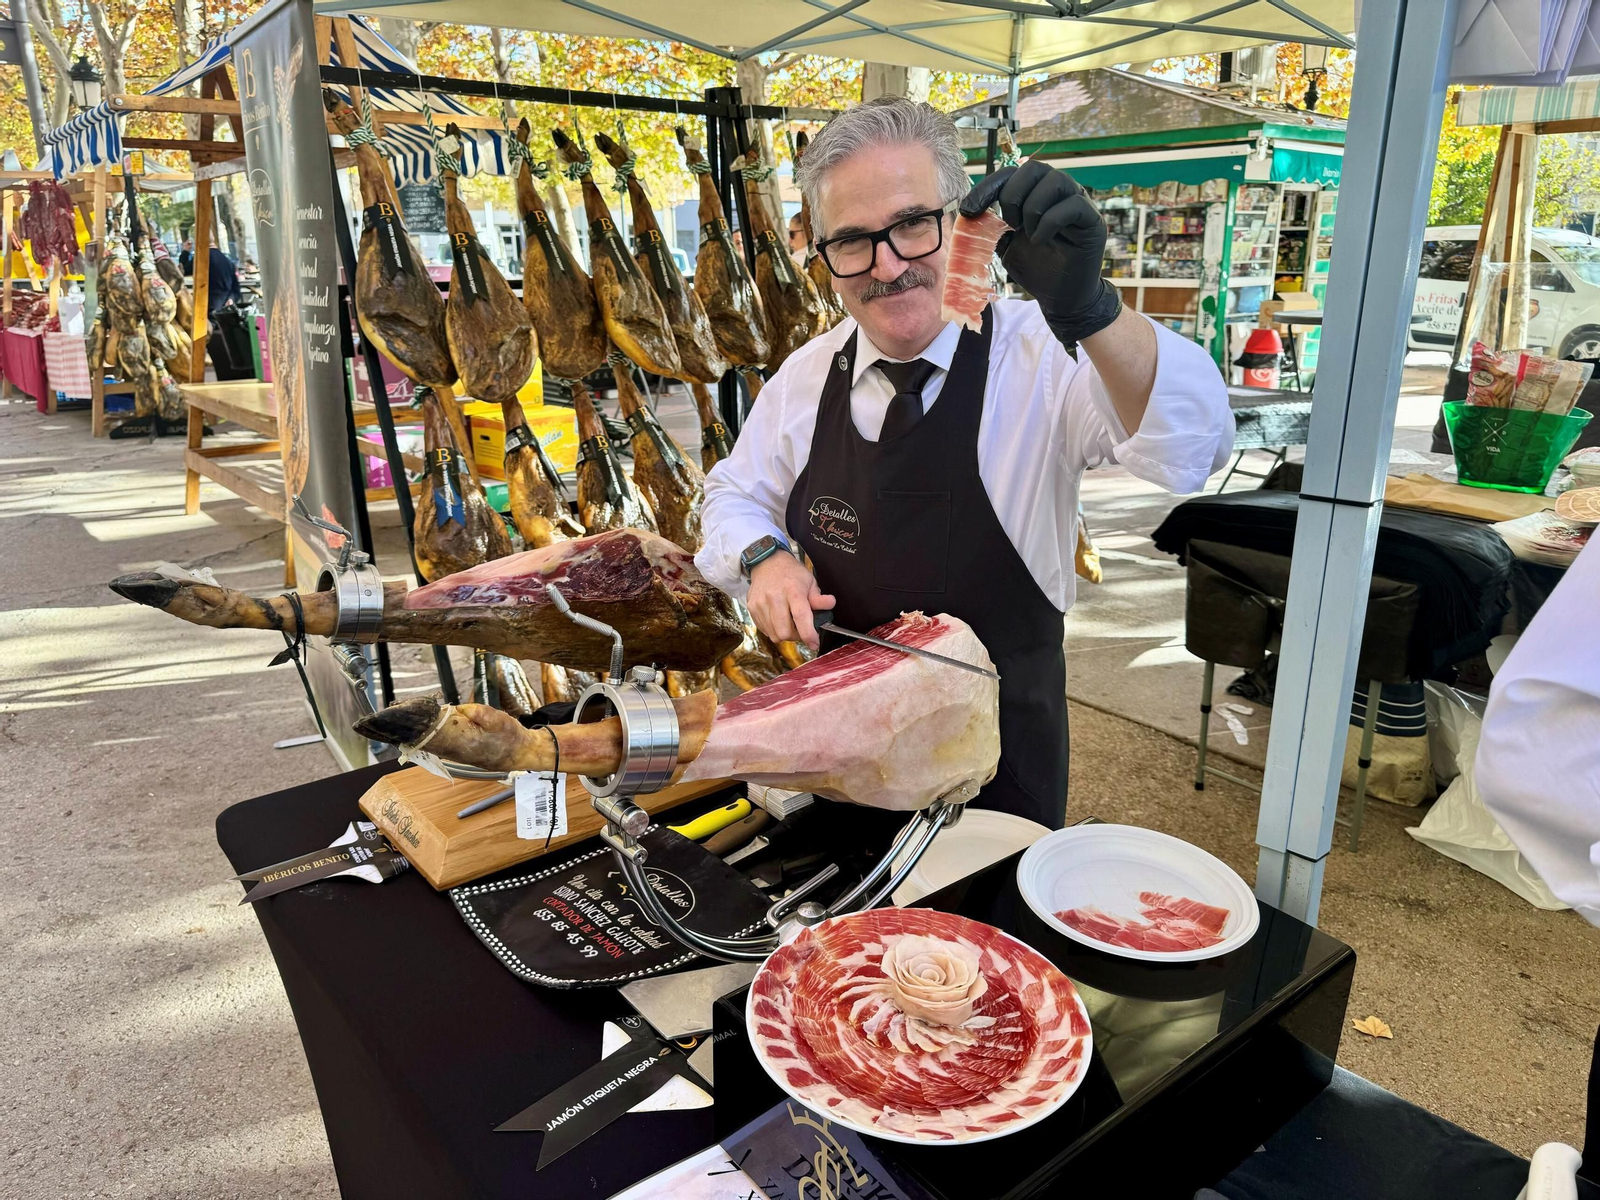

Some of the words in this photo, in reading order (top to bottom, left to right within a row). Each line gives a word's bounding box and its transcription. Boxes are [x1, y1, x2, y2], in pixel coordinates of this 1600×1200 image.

[378, 202, 394, 216] B
[532, 210, 548, 223] B
[599, 218, 614, 231] B
[453, 232, 469, 246] B
[648, 229, 662, 243] B
[764, 230, 777, 242] B
[1428, 291, 1458, 304] Fritas
[1446, 305, 1459, 316] de
[712, 423, 725, 435] B
[595, 435, 609, 448] B
[436, 448, 452, 463] B
[1486, 445, 1501, 453] VIDA
[820, 503, 856, 523] Detalles
[262, 863, 313, 884] IBÉRICOS
[313, 853, 350, 869] BENITO
[646, 873, 690, 908] Detalles
[552, 885, 580, 902] ISIDRO
[573, 898, 612, 928] SANCHEZ
[543, 896, 585, 926] CORTADOR
[580, 923, 591, 934] DE
[589, 930, 625, 959] JAMÓN
[601, 901, 620, 915] con
[617, 914, 632, 926] la
[630, 923, 670, 950] calidad
[533, 908, 556, 921] 655
[551, 920, 570, 932] 85
[566, 932, 585, 945] 45
[579, 945, 599, 958] 99
[545, 1103, 584, 1132] JAMÓN
[582, 1077, 627, 1107] ETIQUETA
[624, 1056, 658, 1080] NEGRA
